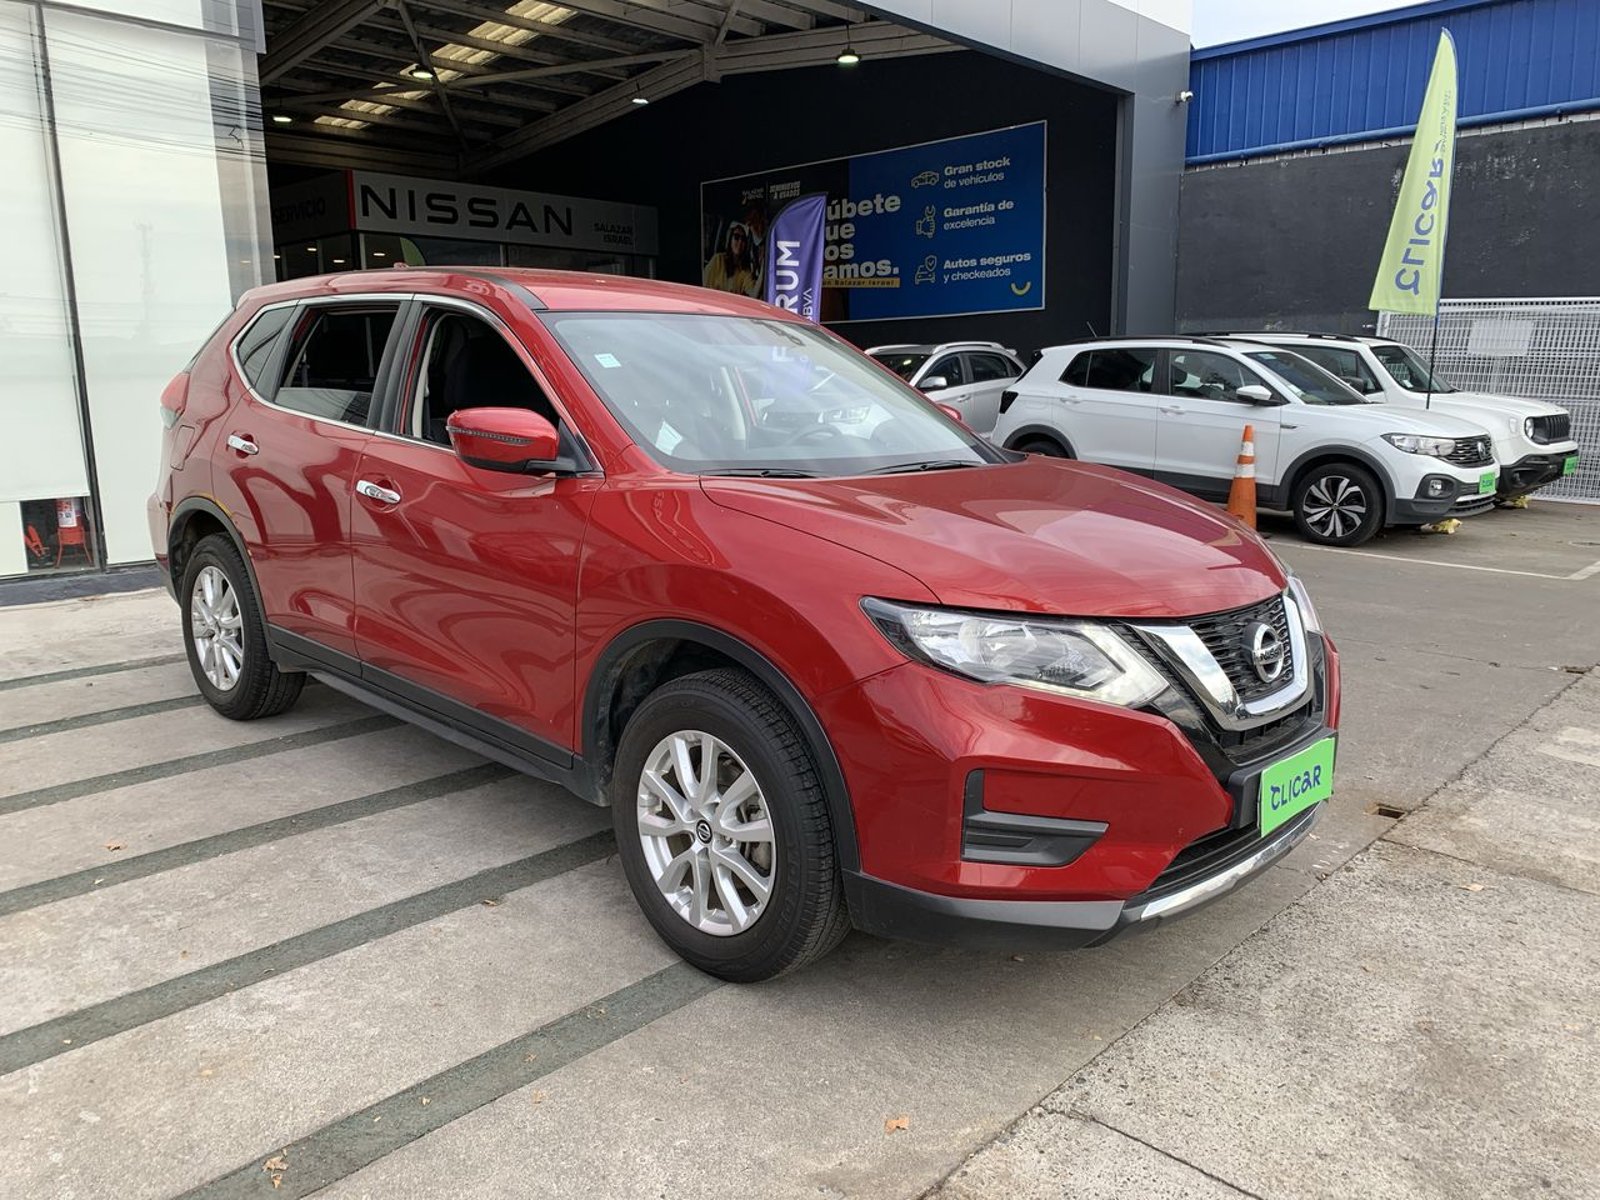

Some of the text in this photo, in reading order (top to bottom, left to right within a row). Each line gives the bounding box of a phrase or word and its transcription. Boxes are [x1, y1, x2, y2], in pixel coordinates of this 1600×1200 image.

[944, 156, 1011, 176] Gran stock
[944, 172, 1005, 189] de vehículos
[360, 184, 572, 236] NISSAN
[826, 193, 901, 220] úbete
[943, 200, 1014, 217] Garantía de
[825, 222, 855, 241] ue
[943, 215, 995, 230] excelencia
[824, 243, 855, 261] os
[823, 259, 900, 279] amos.
[943, 253, 1031, 270] Autos seguros
[943, 267, 1011, 284] y checkeados
[802, 288, 813, 320] BVA
